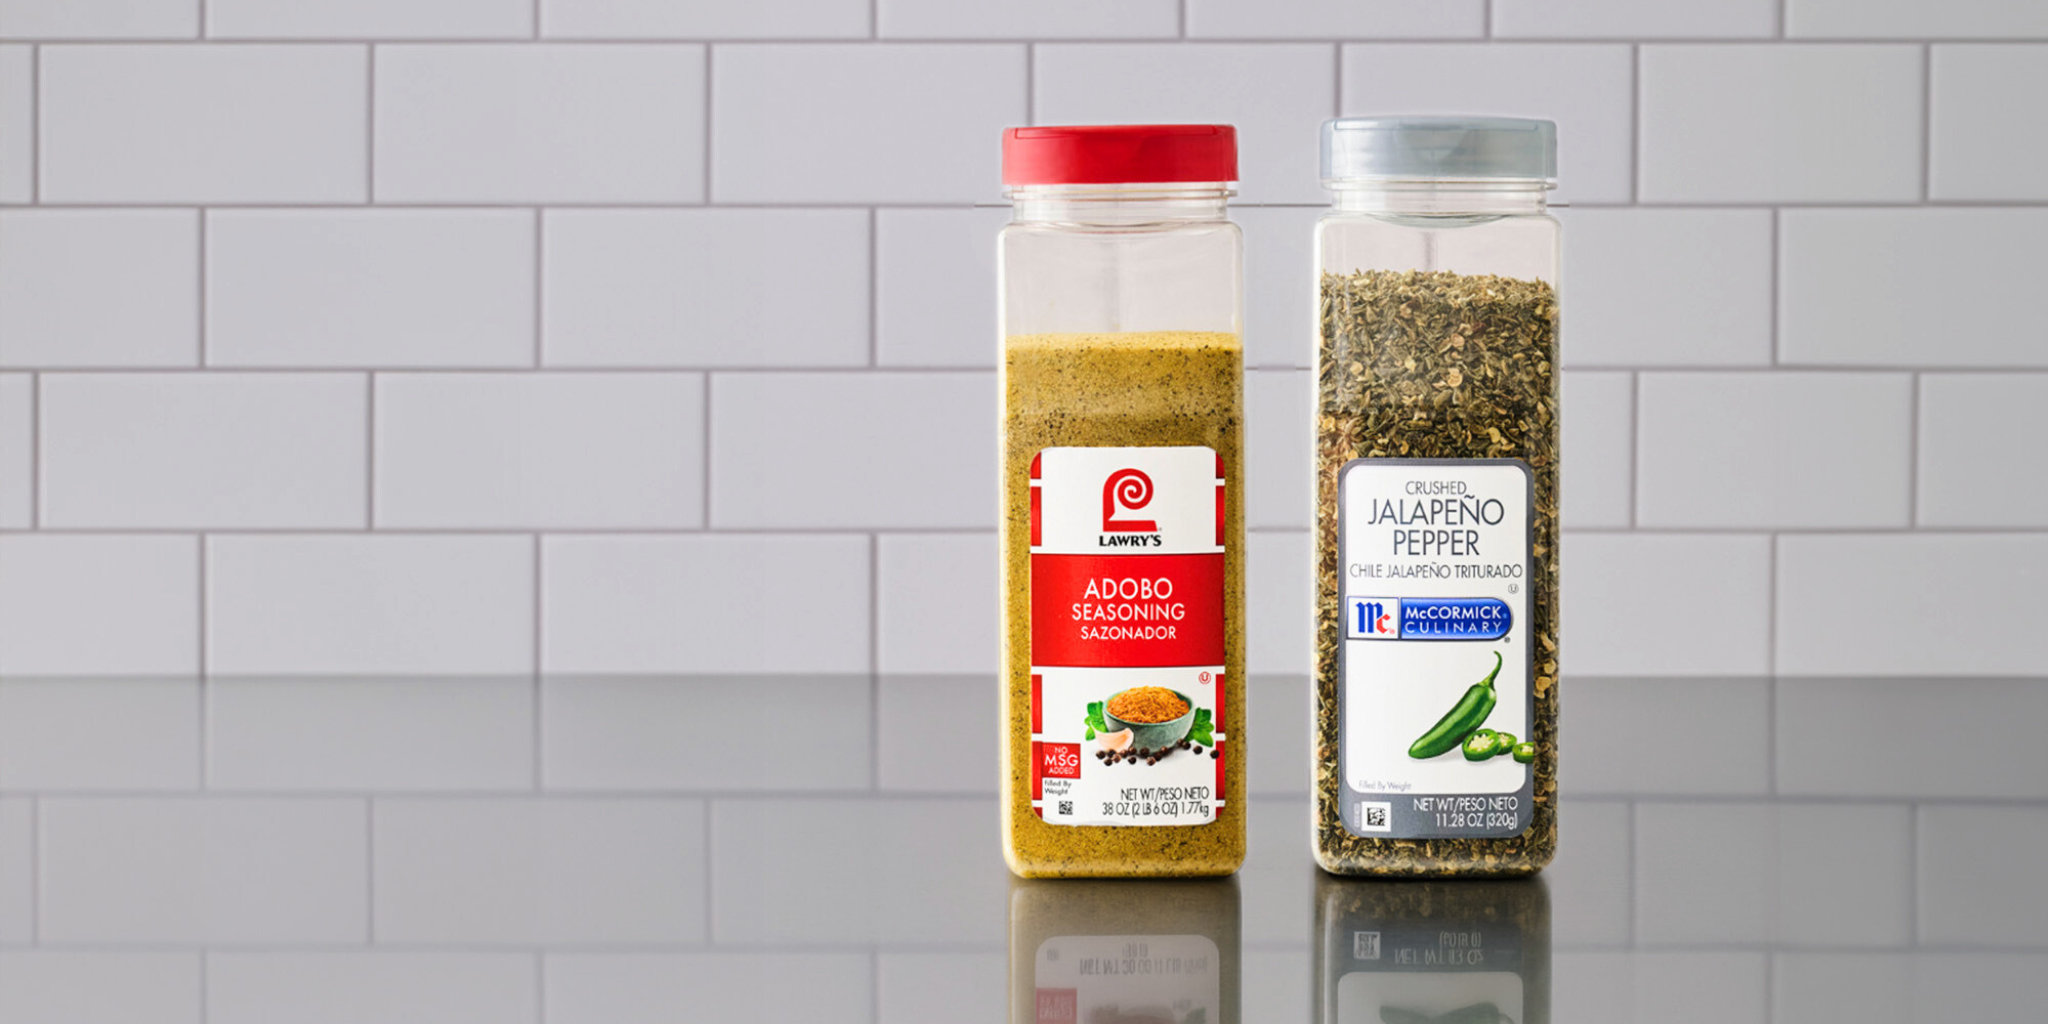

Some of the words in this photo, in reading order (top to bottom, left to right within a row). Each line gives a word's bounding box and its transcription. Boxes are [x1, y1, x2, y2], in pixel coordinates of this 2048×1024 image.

[1405, 481, 1467, 495] CRUSHED
[1368, 494, 1505, 526] JALAPEÑO
[1099, 534, 1162, 547] LAWRY'S
[1393, 529, 1480, 556] PEPPER
[1349, 563, 1383, 578] CHILE
[1386, 562, 1451, 579] JALAPEÑO
[1455, 563, 1523, 578] TRITURADO
[1083, 577, 1173, 600] ADOBO
[1072, 603, 1186, 621] SEASONING
[1405, 606, 1502, 620] McCORMICK
[1080, 626, 1177, 640] SAZONADOR
[1404, 621, 1503, 634] CULINARY
[1054, 746, 1068, 755] NO
[1044, 754, 1079, 766] MSG
[1048, 766, 1075, 775] ADDED
[1121, 788, 1138, 801] NET
[1139, 787, 1182, 803] WT/PESO
[1184, 786, 1210, 800] NETO
[1102, 802, 1114, 816] 38
[1115, 802, 1130, 816] OZ
[1131, 802, 1141, 819] (2
[1142, 802, 1152, 816] LB
[1153, 802, 1160, 816] 6
[1161, 801, 1178, 818] OZ)
[1413, 797, 1434, 811] NET
[1436, 797, 1486, 813] WT/PESO
[1488, 796, 1518, 811] NETO
[1436, 813, 1465, 828] 11.28
[1467, 813, 1484, 828] OZ
[1486, 812, 1518, 830] (320g)
